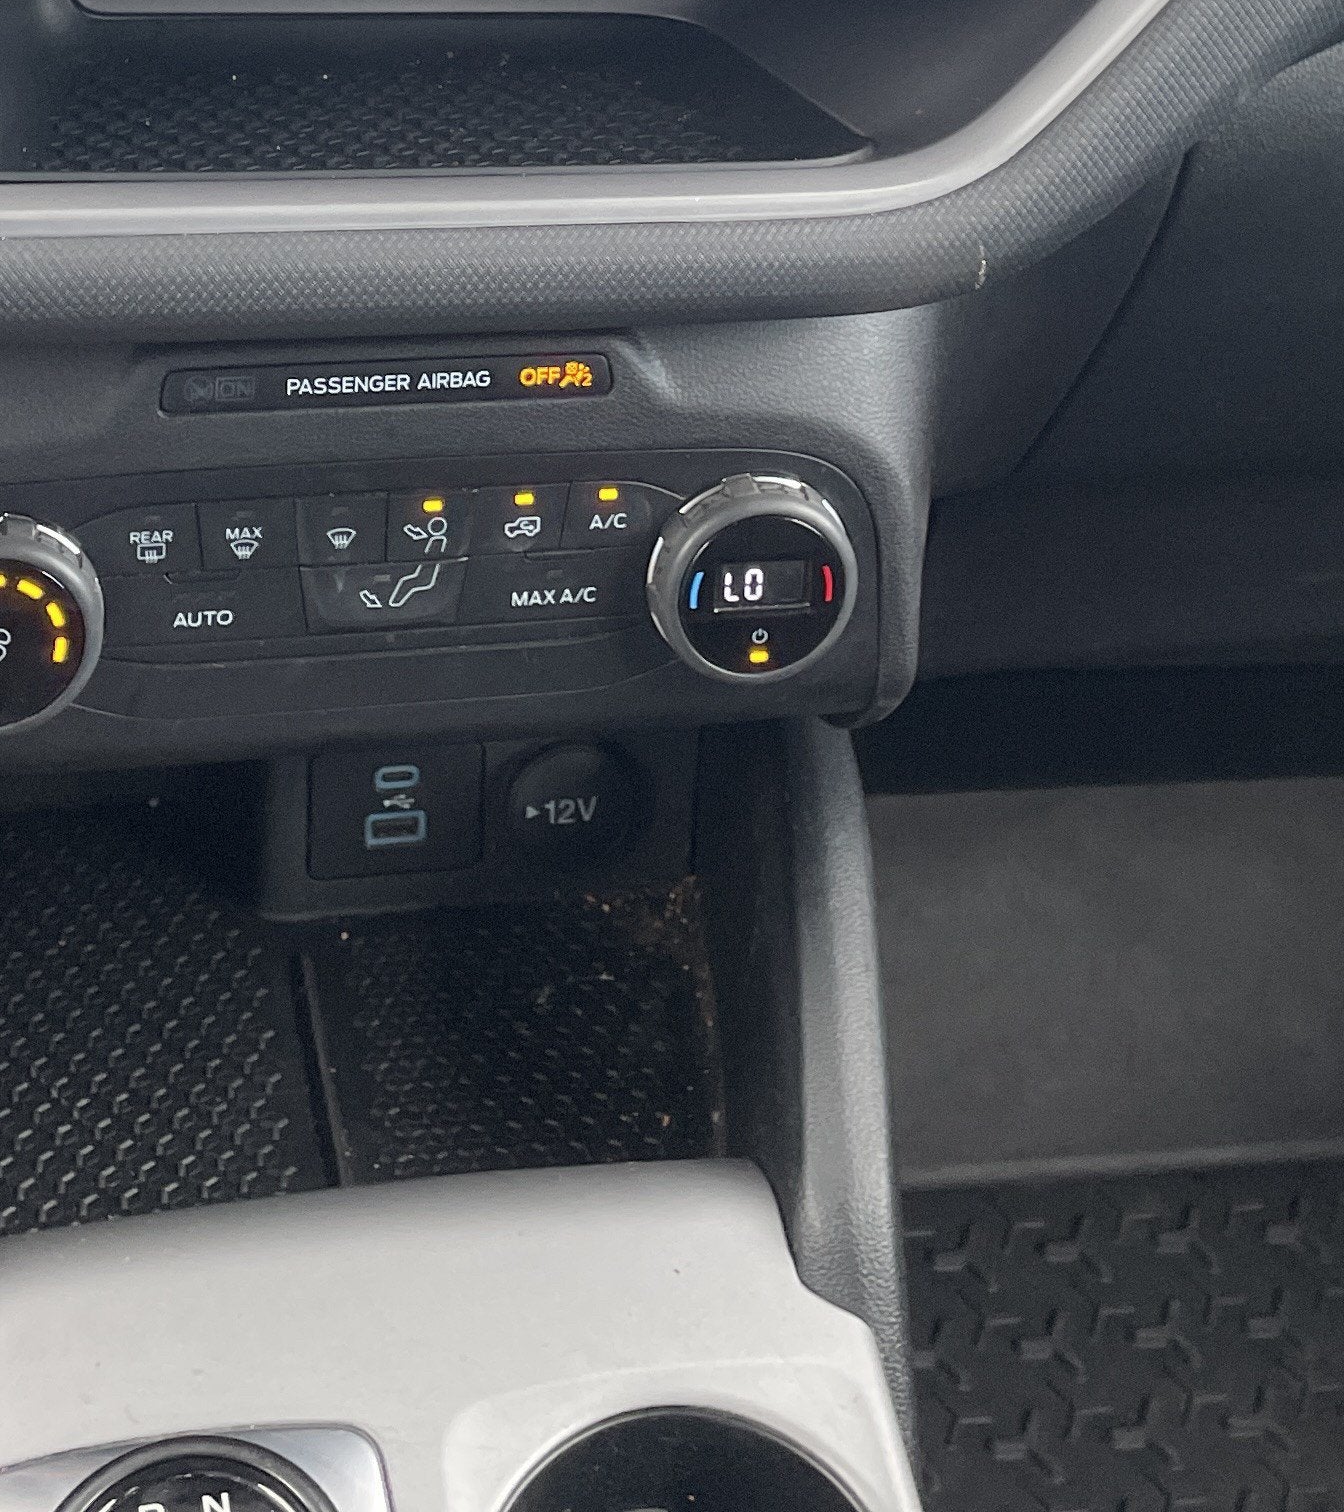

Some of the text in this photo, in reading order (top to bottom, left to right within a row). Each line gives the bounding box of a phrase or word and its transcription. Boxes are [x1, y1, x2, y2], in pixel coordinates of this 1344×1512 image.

[286, 370, 491, 396] PASSENGER AIRBAG
[519, 366, 561, 387] OFF
[589, 512, 627, 530] A/C
[129, 529, 174, 548] REAR
[225, 526, 263, 542] MAX
[511, 586, 597, 607] MAX A/C
[173, 609, 234, 628] AUTO
[544, 795, 597, 824] 12V
